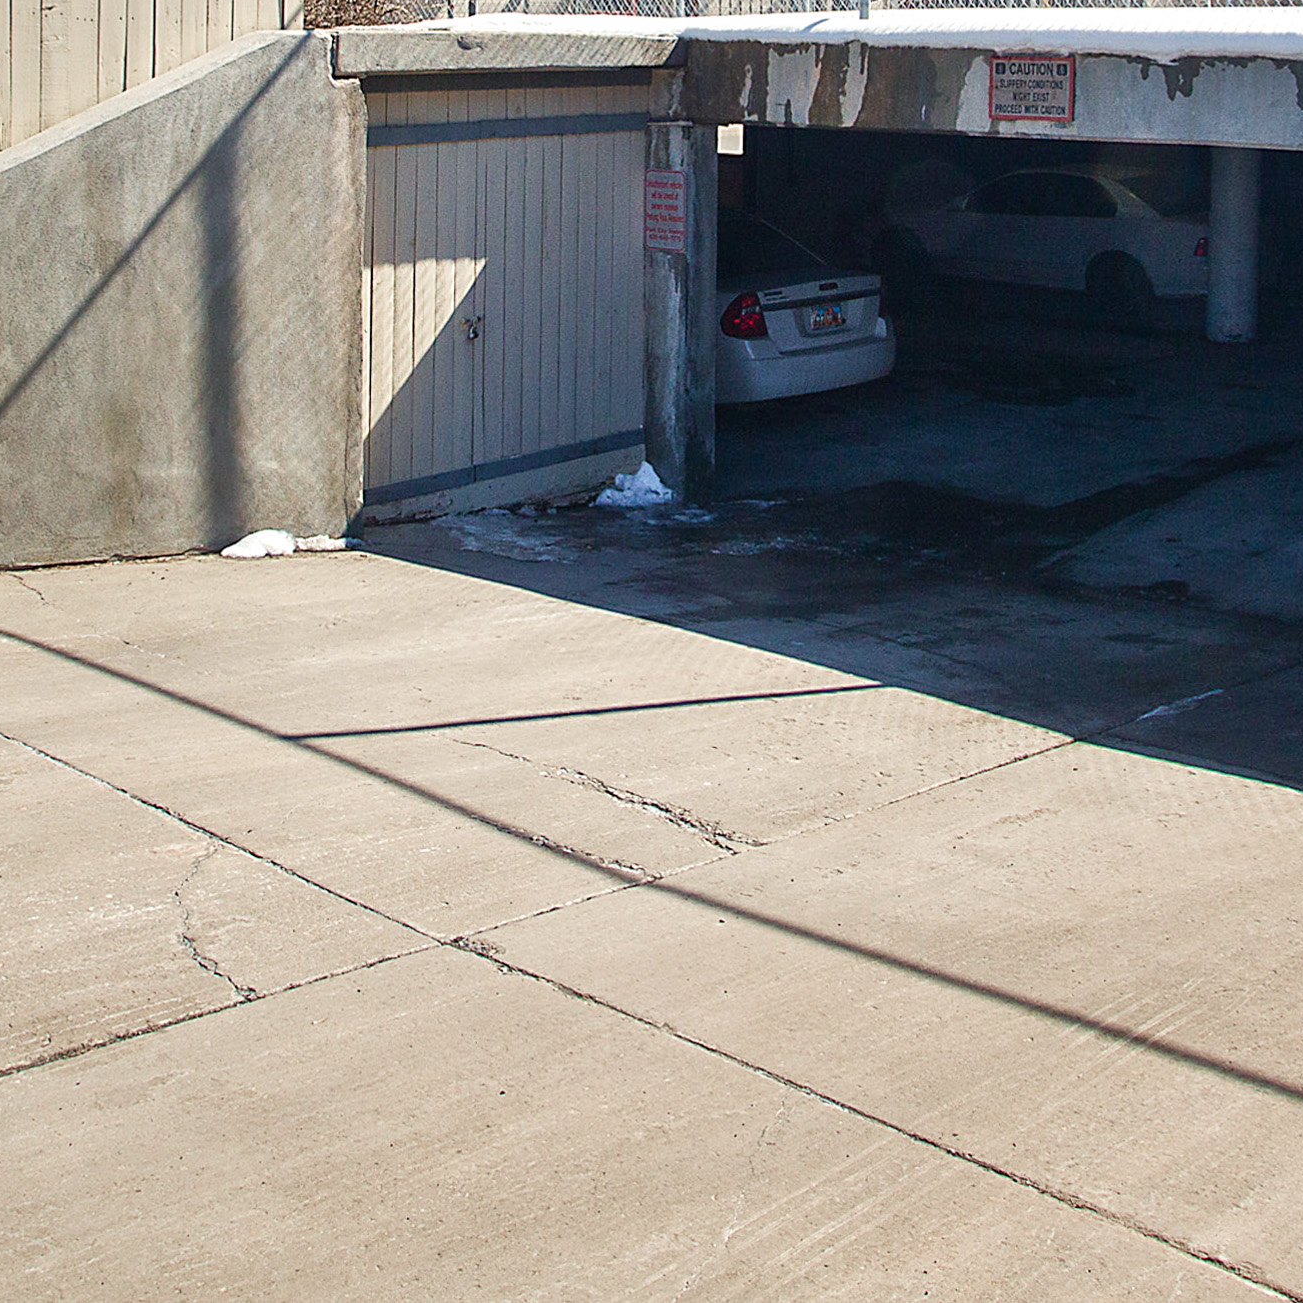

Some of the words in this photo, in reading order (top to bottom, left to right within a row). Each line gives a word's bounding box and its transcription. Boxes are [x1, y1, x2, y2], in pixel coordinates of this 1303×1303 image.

[1009, 62, 1054, 76] CAUTION
[1000, 79, 1027, 89] SLIPPERY
[1028, 80, 1063, 90] CONDITIONS
[1033, 92, 1050, 102] EXIST
[995, 104, 1022, 113] PROCEED
[1024, 104, 1038, 115] WITH
[1040, 105, 1066, 115] CAUTION
